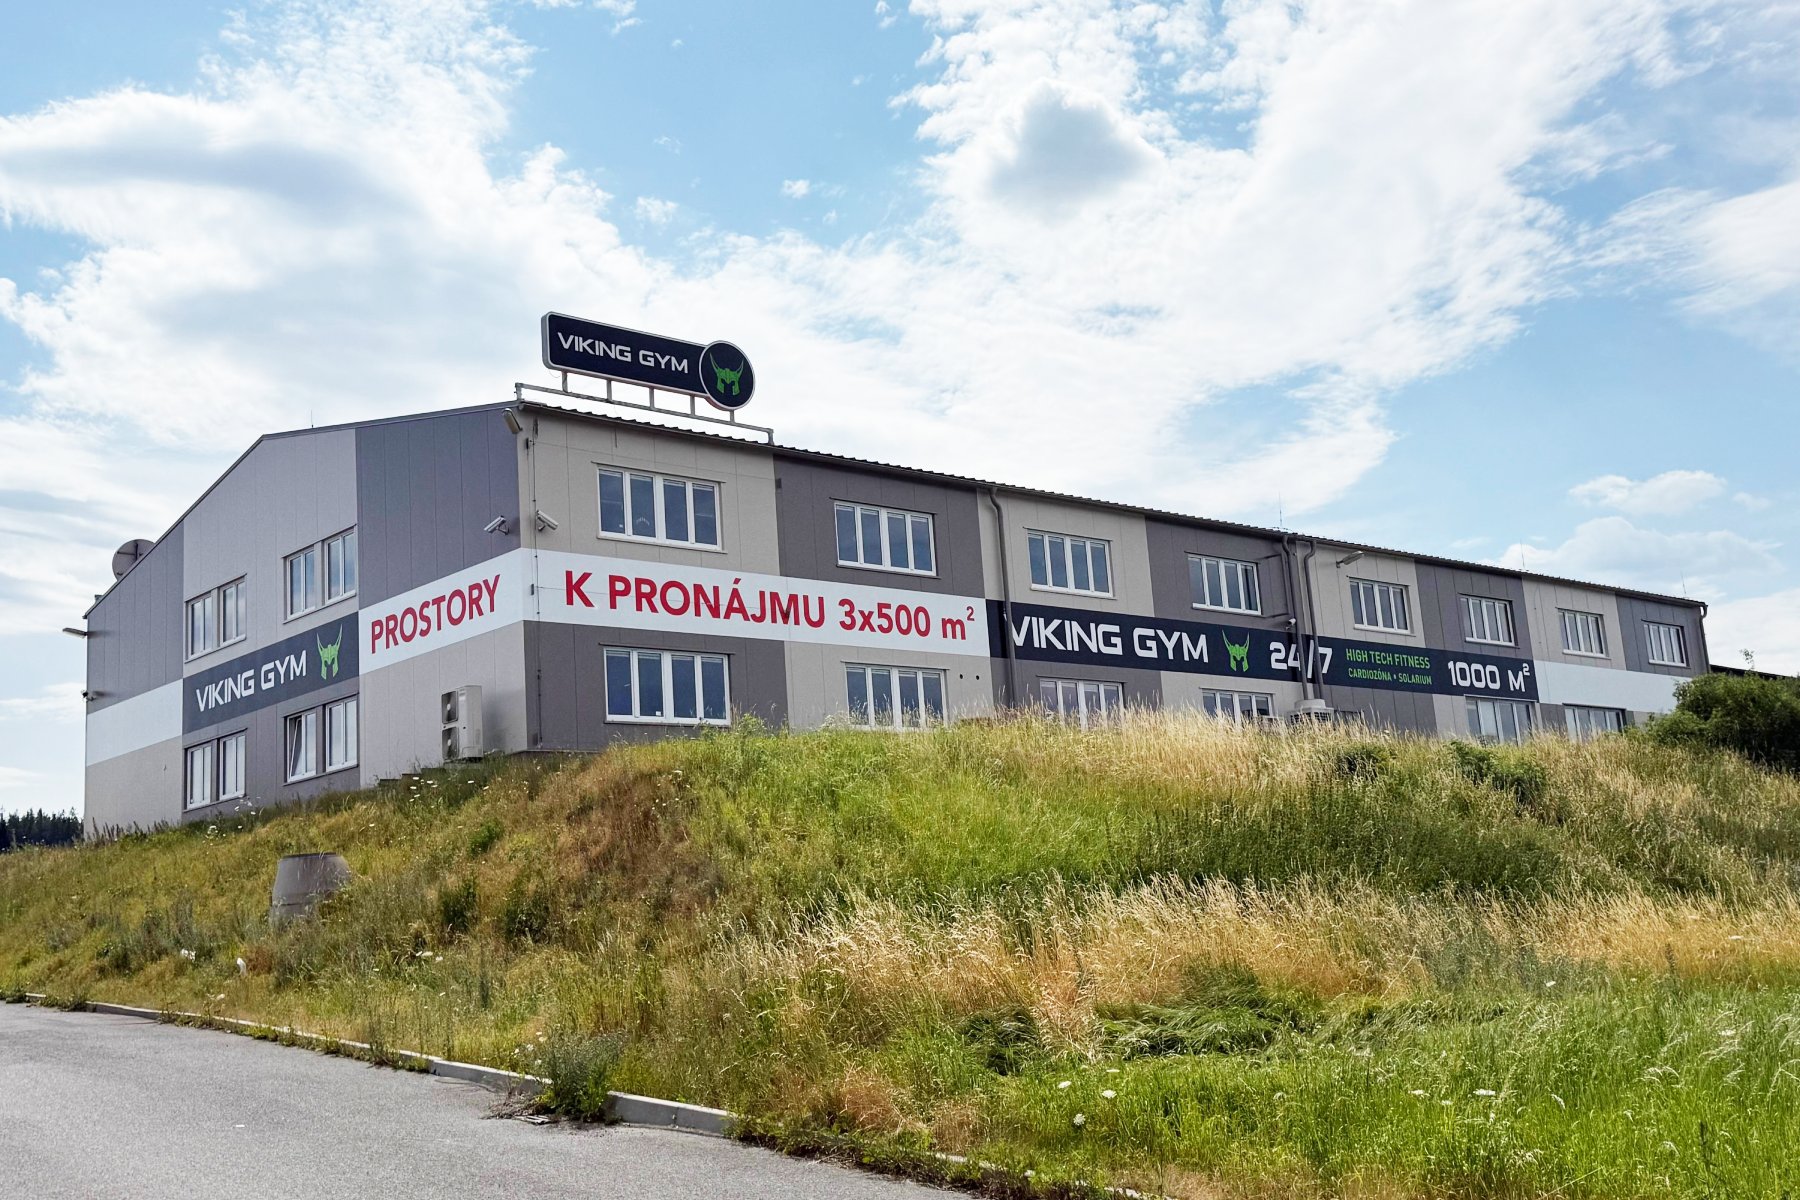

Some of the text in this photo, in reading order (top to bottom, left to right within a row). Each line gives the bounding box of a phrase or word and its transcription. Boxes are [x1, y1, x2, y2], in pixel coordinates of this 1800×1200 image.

[557, 331, 689, 374] VIKING GYM
[371, 573, 501, 655] PROSTORY
[565, 570, 595, 608] K
[608, 574, 826, 629] PRONÁJMU
[838, 598, 931, 637] 3x500
[1003, 612, 1209, 663] VIKING GYM
[1269, 639, 1333, 679] 24/7
[1345, 648, 1431, 669] HIGH TECH FITNESS
[196, 649, 307, 713] VIKING GYM
[1348, 667, 1432, 685] CARDIOZÓNA SOLARIUM
[1447, 660, 1501, 690] 1000
